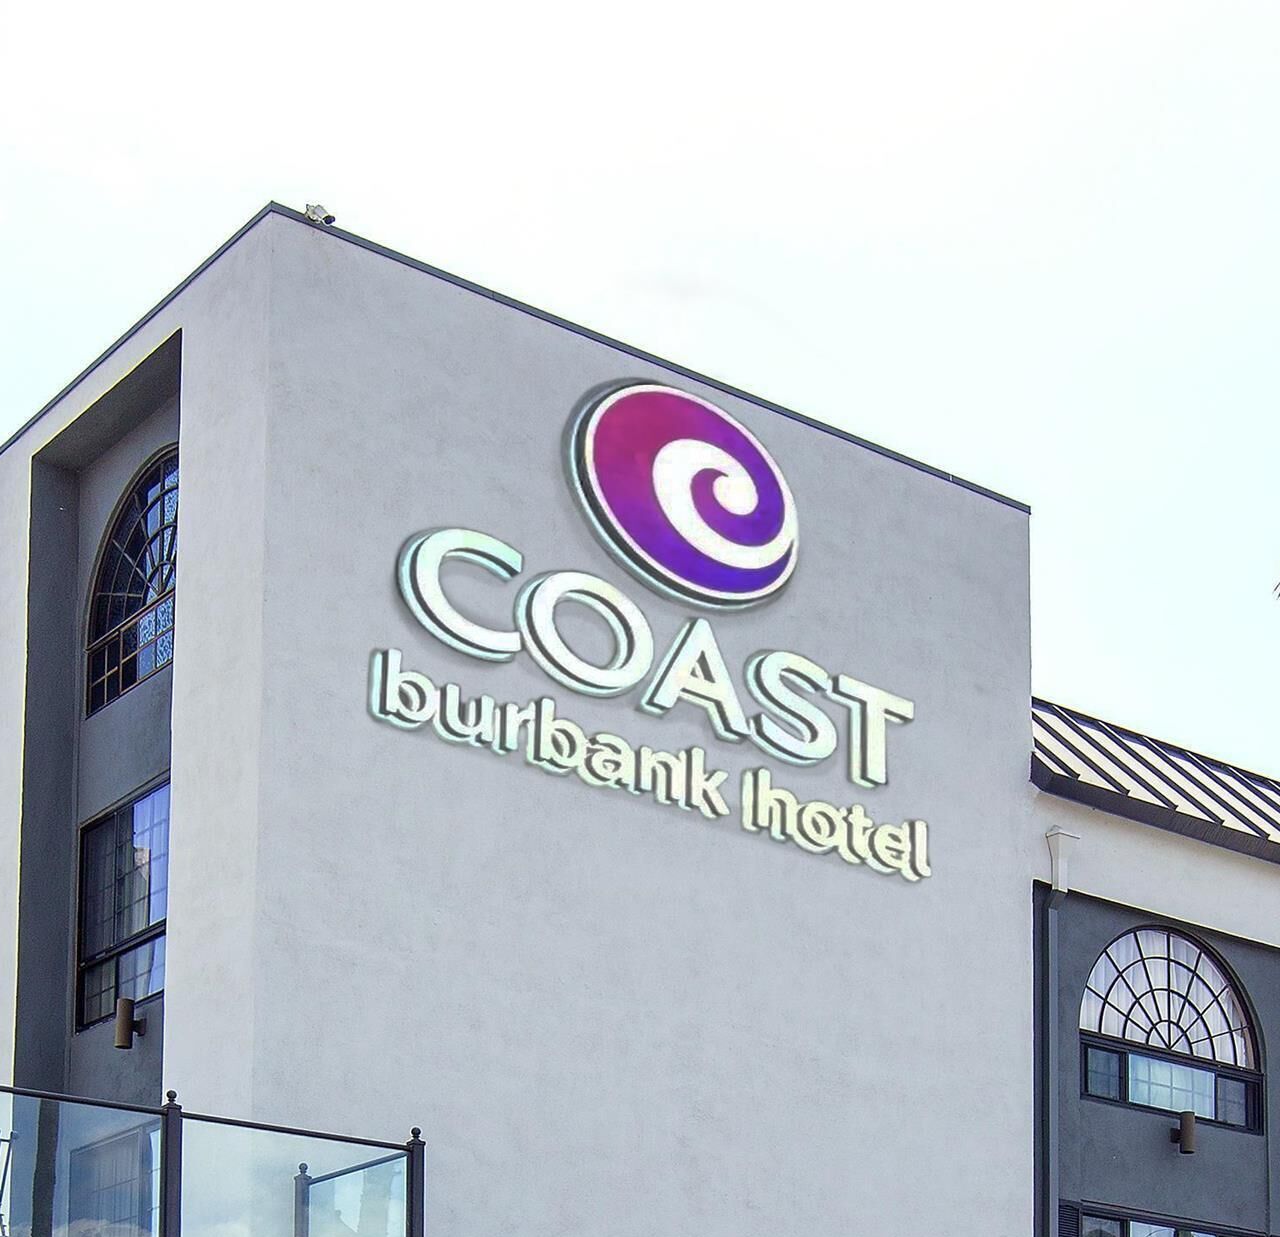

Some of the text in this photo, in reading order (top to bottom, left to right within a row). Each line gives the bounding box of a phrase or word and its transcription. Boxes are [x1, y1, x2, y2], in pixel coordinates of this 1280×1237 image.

[368, 647, 933, 883] burbank hotel
[397, 526, 915, 788] COAST
